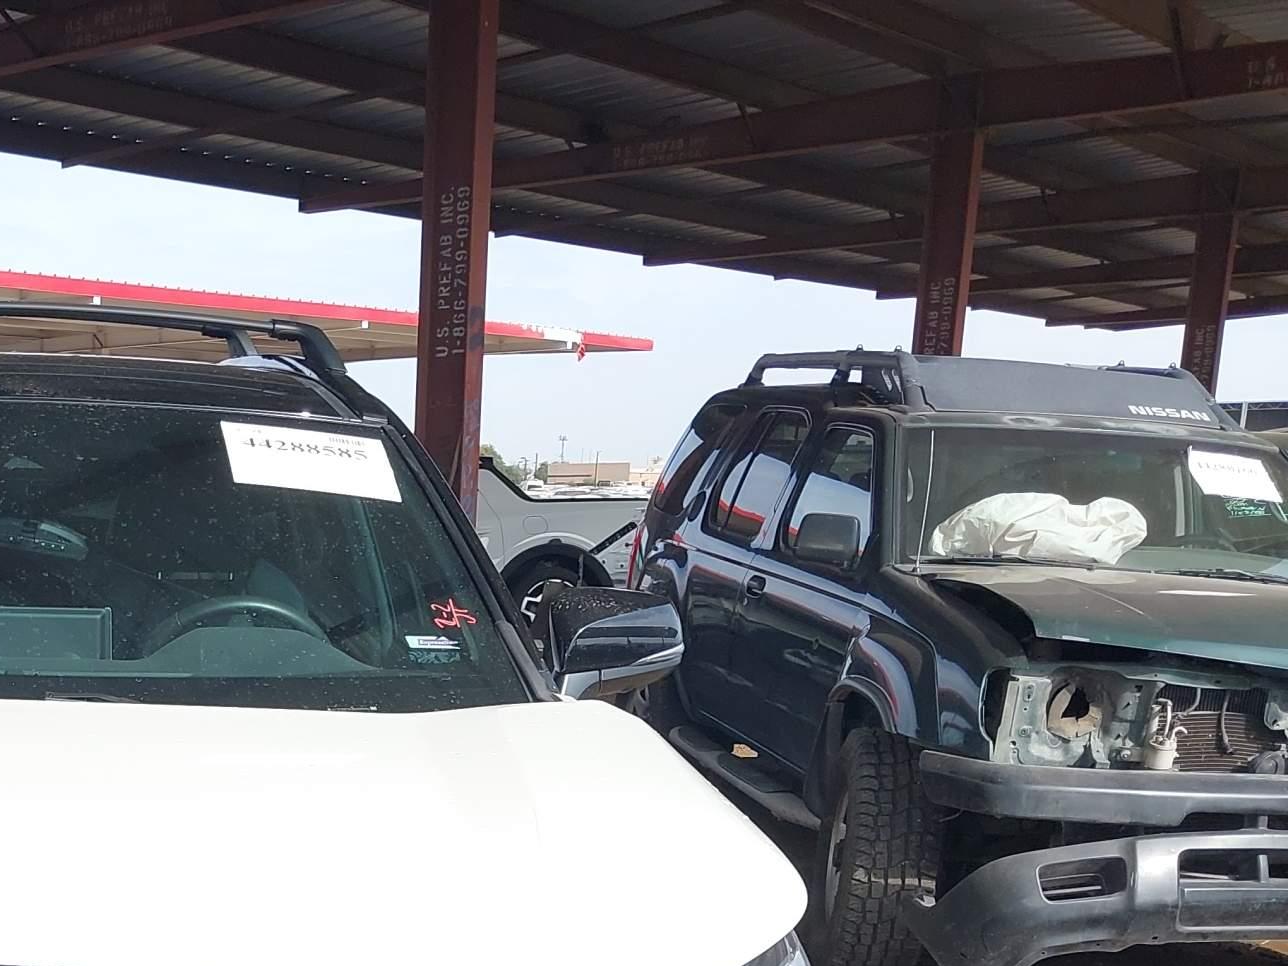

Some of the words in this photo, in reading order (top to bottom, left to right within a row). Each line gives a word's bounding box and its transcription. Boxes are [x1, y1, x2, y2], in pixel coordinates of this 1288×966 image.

[440, 185, 455, 225] INC.
[438, 235, 453, 310] PREFAB
[451, 186, 471, 355] 1-866-799-0969
[1127, 405, 1212, 422] NISSAN
[242, 437, 368, 461] 44288585
